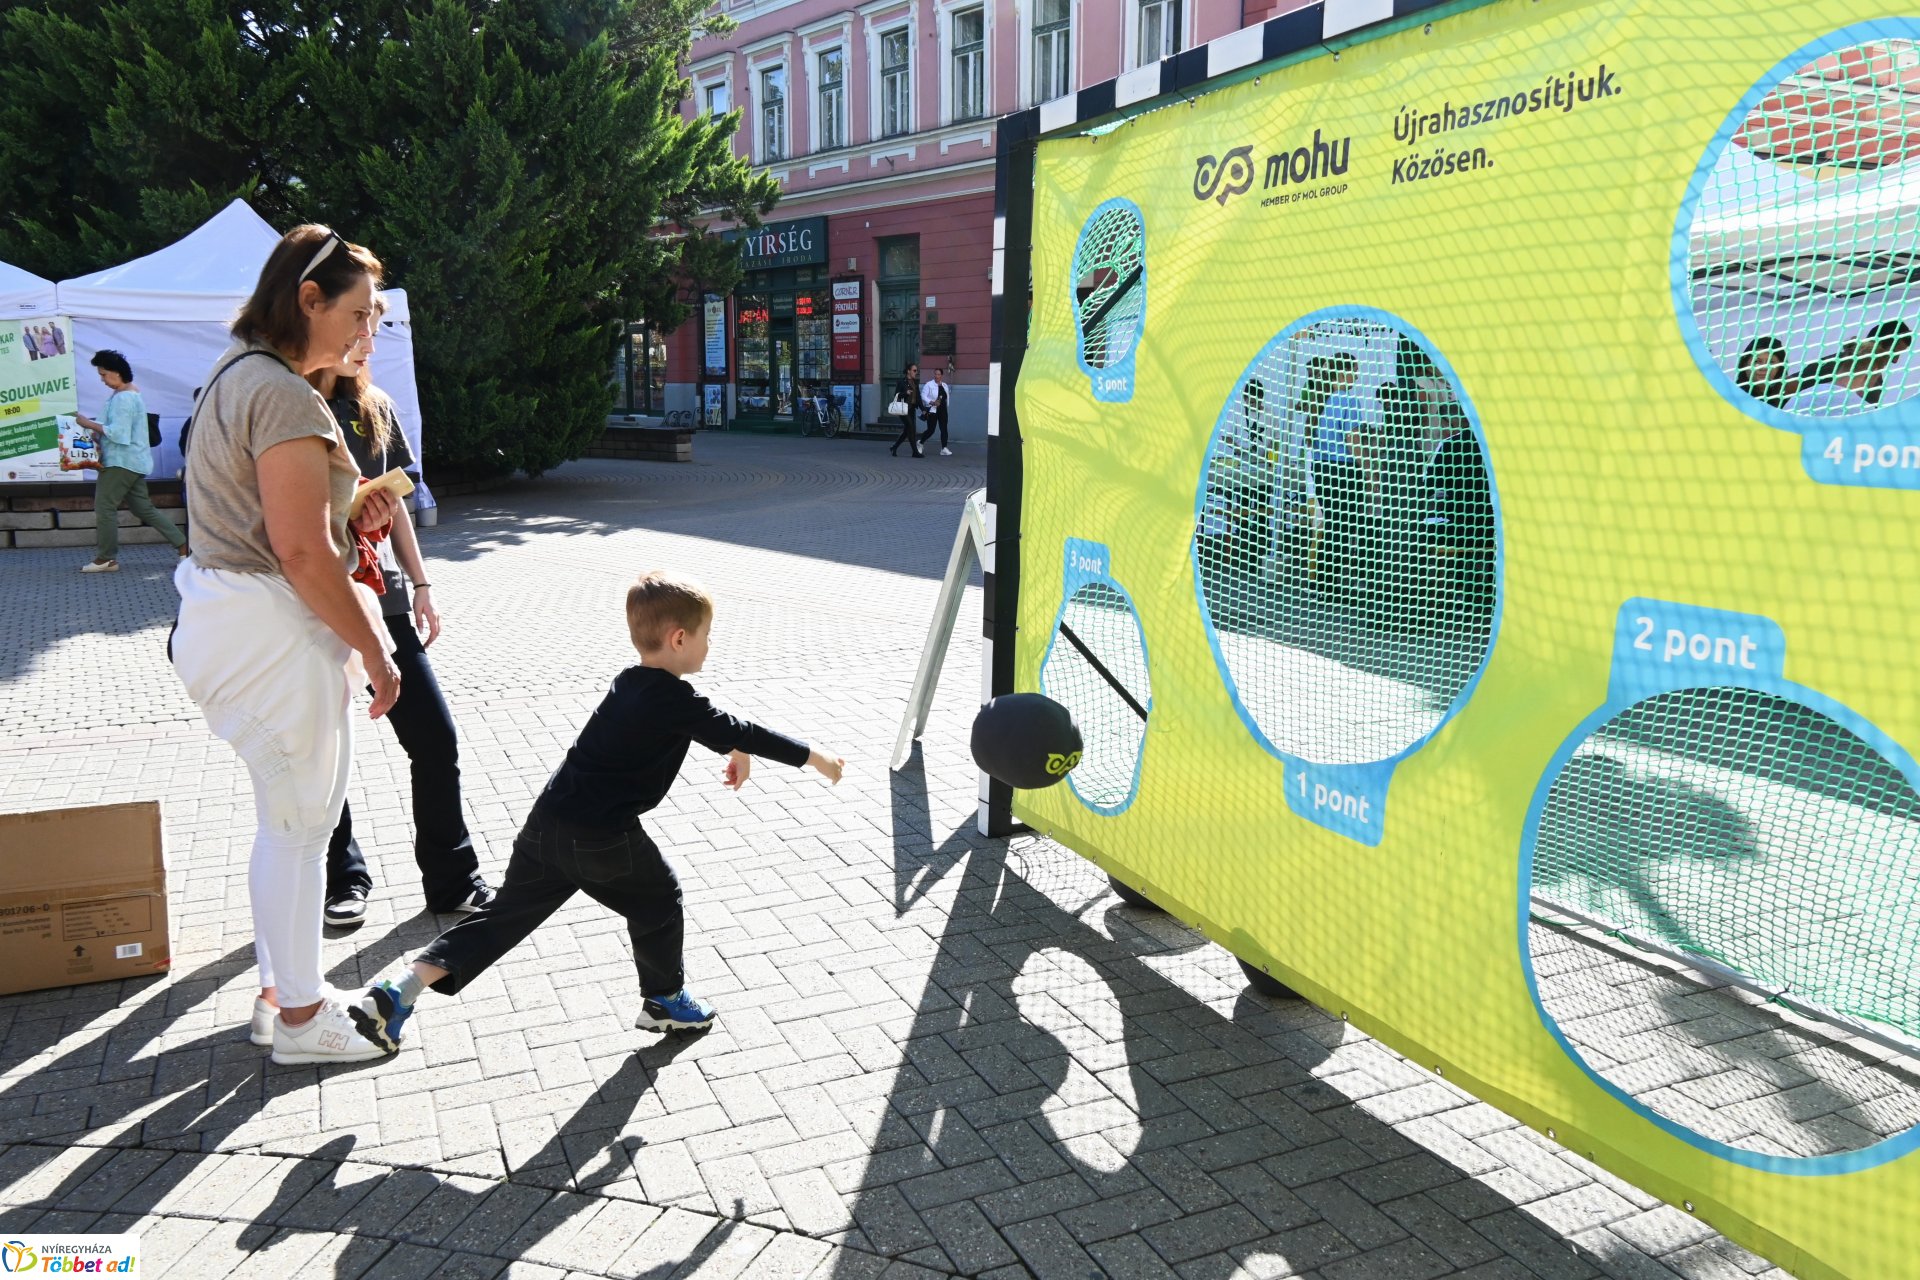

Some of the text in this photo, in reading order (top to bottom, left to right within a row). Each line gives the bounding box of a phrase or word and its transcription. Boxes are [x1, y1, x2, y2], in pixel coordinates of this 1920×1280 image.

[1394, 64, 1622, 146] Újrahasznosítjuk.
[1264, 128, 1351, 190] mohu
[1391, 147, 1494, 185] Közösen.
[1260, 183, 1348, 208] MEMBER OF MOL GROUP
[732, 224, 812, 258] YÍRSÉG
[0, 333, 14, 345] KAR
[0, 377, 70, 403] SOULWAVE
[1097, 376, 1127, 393] 5 pont
[1823, 436, 1920, 473] 4 pon
[1070, 550, 1102, 575] 3 pont
[1633, 616, 1757, 670] 2 pont
[1297, 771, 1370, 824] 1 pont
